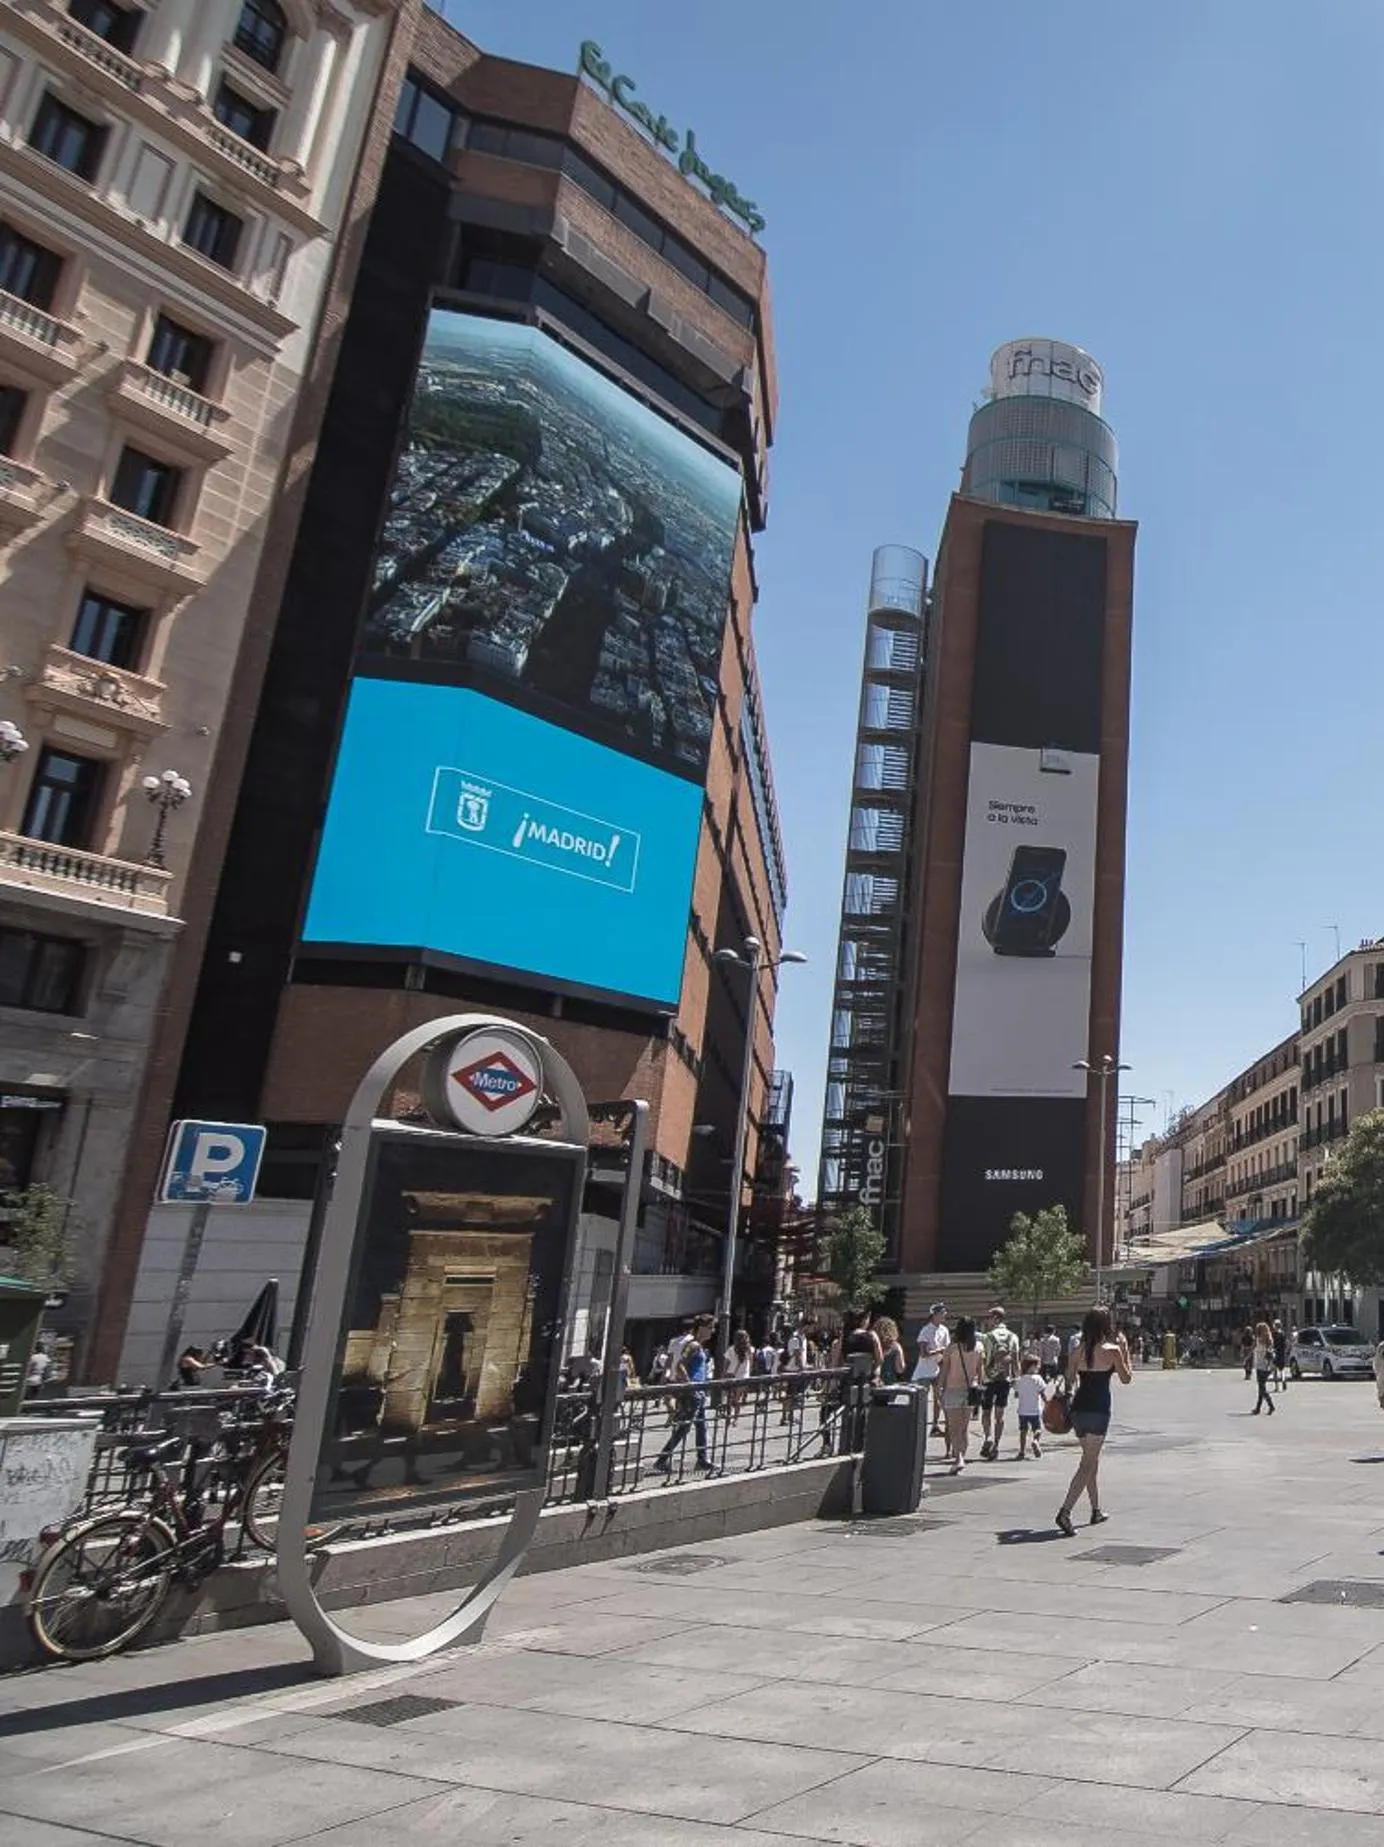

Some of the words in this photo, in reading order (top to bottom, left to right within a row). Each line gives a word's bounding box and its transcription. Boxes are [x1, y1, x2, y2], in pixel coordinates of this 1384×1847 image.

[512, 812, 621, 868] ¡MADRID!
[471, 1071, 517, 1092] Metro
[188, 1132, 246, 1190] P
[859, 1139, 885, 1205] fnac
[984, 1169, 1044, 1181] SAMSUNG
